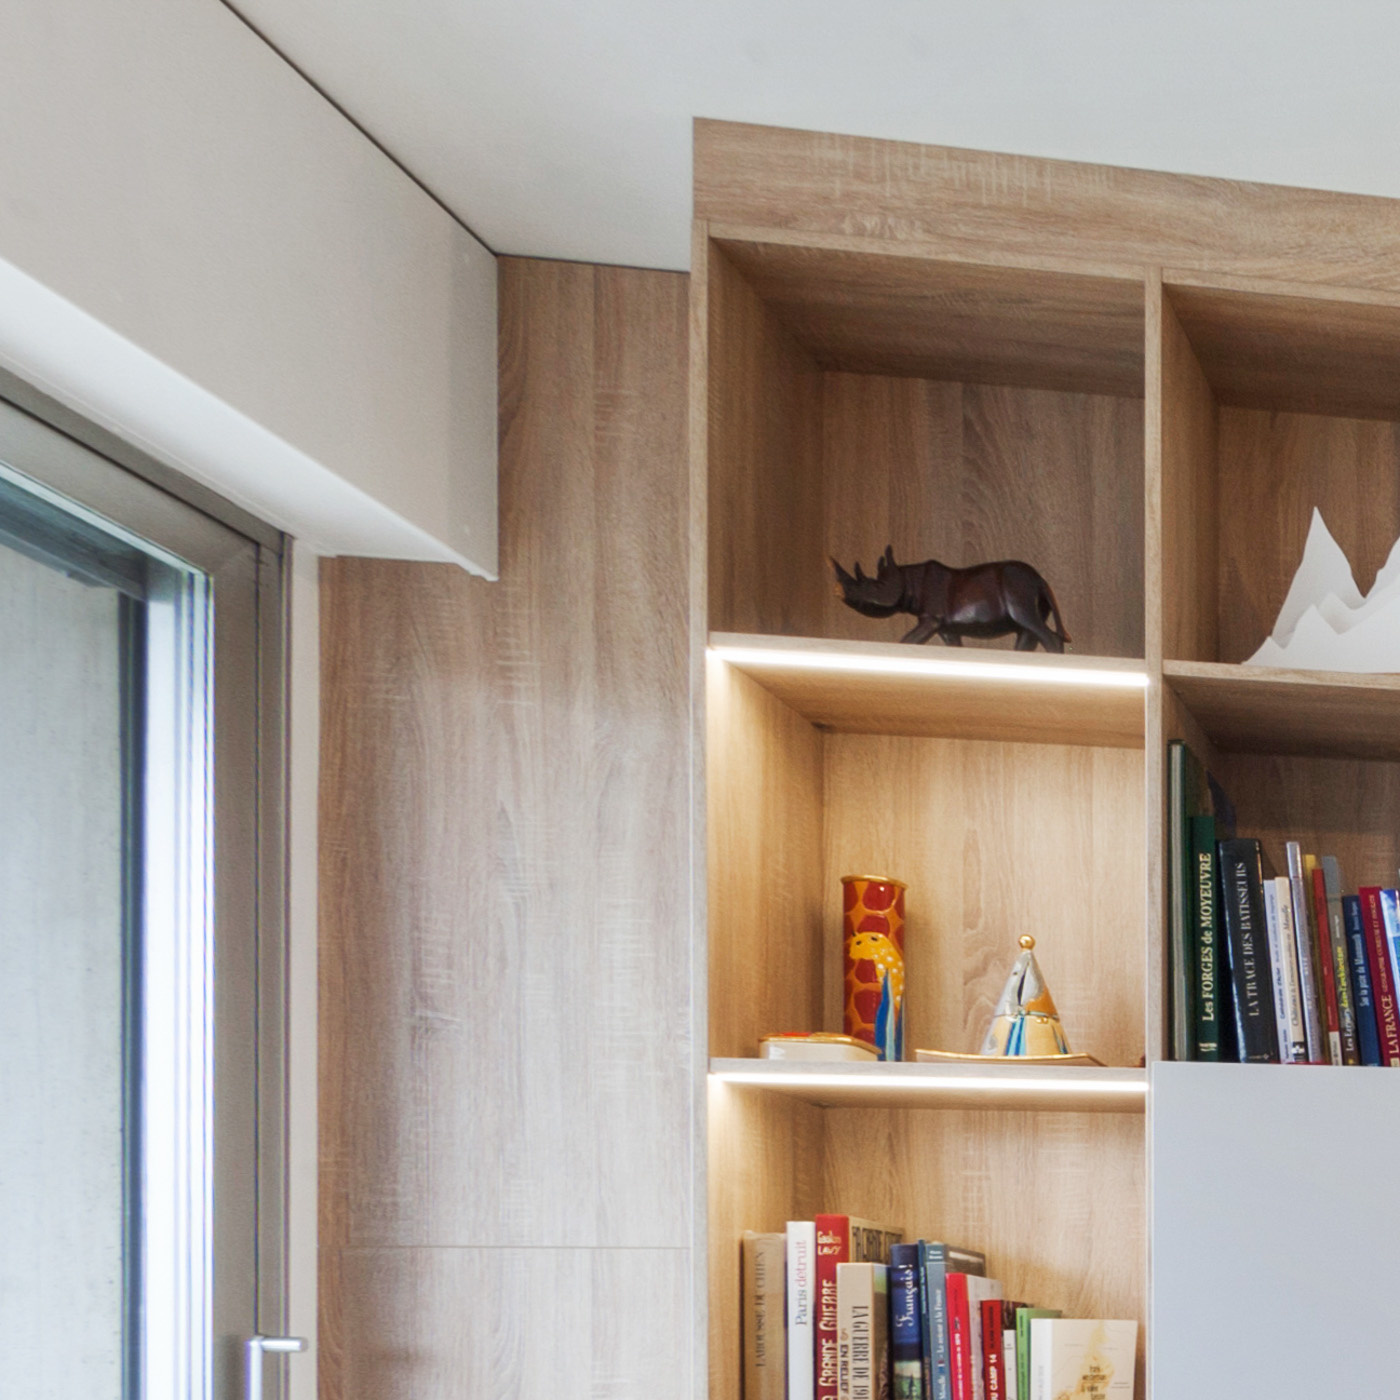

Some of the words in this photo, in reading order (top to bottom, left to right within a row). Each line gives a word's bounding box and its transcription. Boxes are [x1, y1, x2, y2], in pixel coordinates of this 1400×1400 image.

[1199, 853, 1212, 928] MOYEUVRE
[1201, 931, 1212, 944] de
[1241, 933, 1253, 955] DES
[1200, 947, 1213, 998] FORGES
[1245, 959, 1258, 998] TRACE
[1202, 1002, 1213, 1021] Les
[796, 1289, 808, 1326] Paris
[852, 1305, 869, 1318] LA
[840, 1344, 848, 1357] EN
[852, 1321, 869, 1363] GUERRE
[840, 1360, 849, 1395] RELIEF
[852, 1367, 869, 1380] DE
[989, 1366, 998, 1390] CAMP
